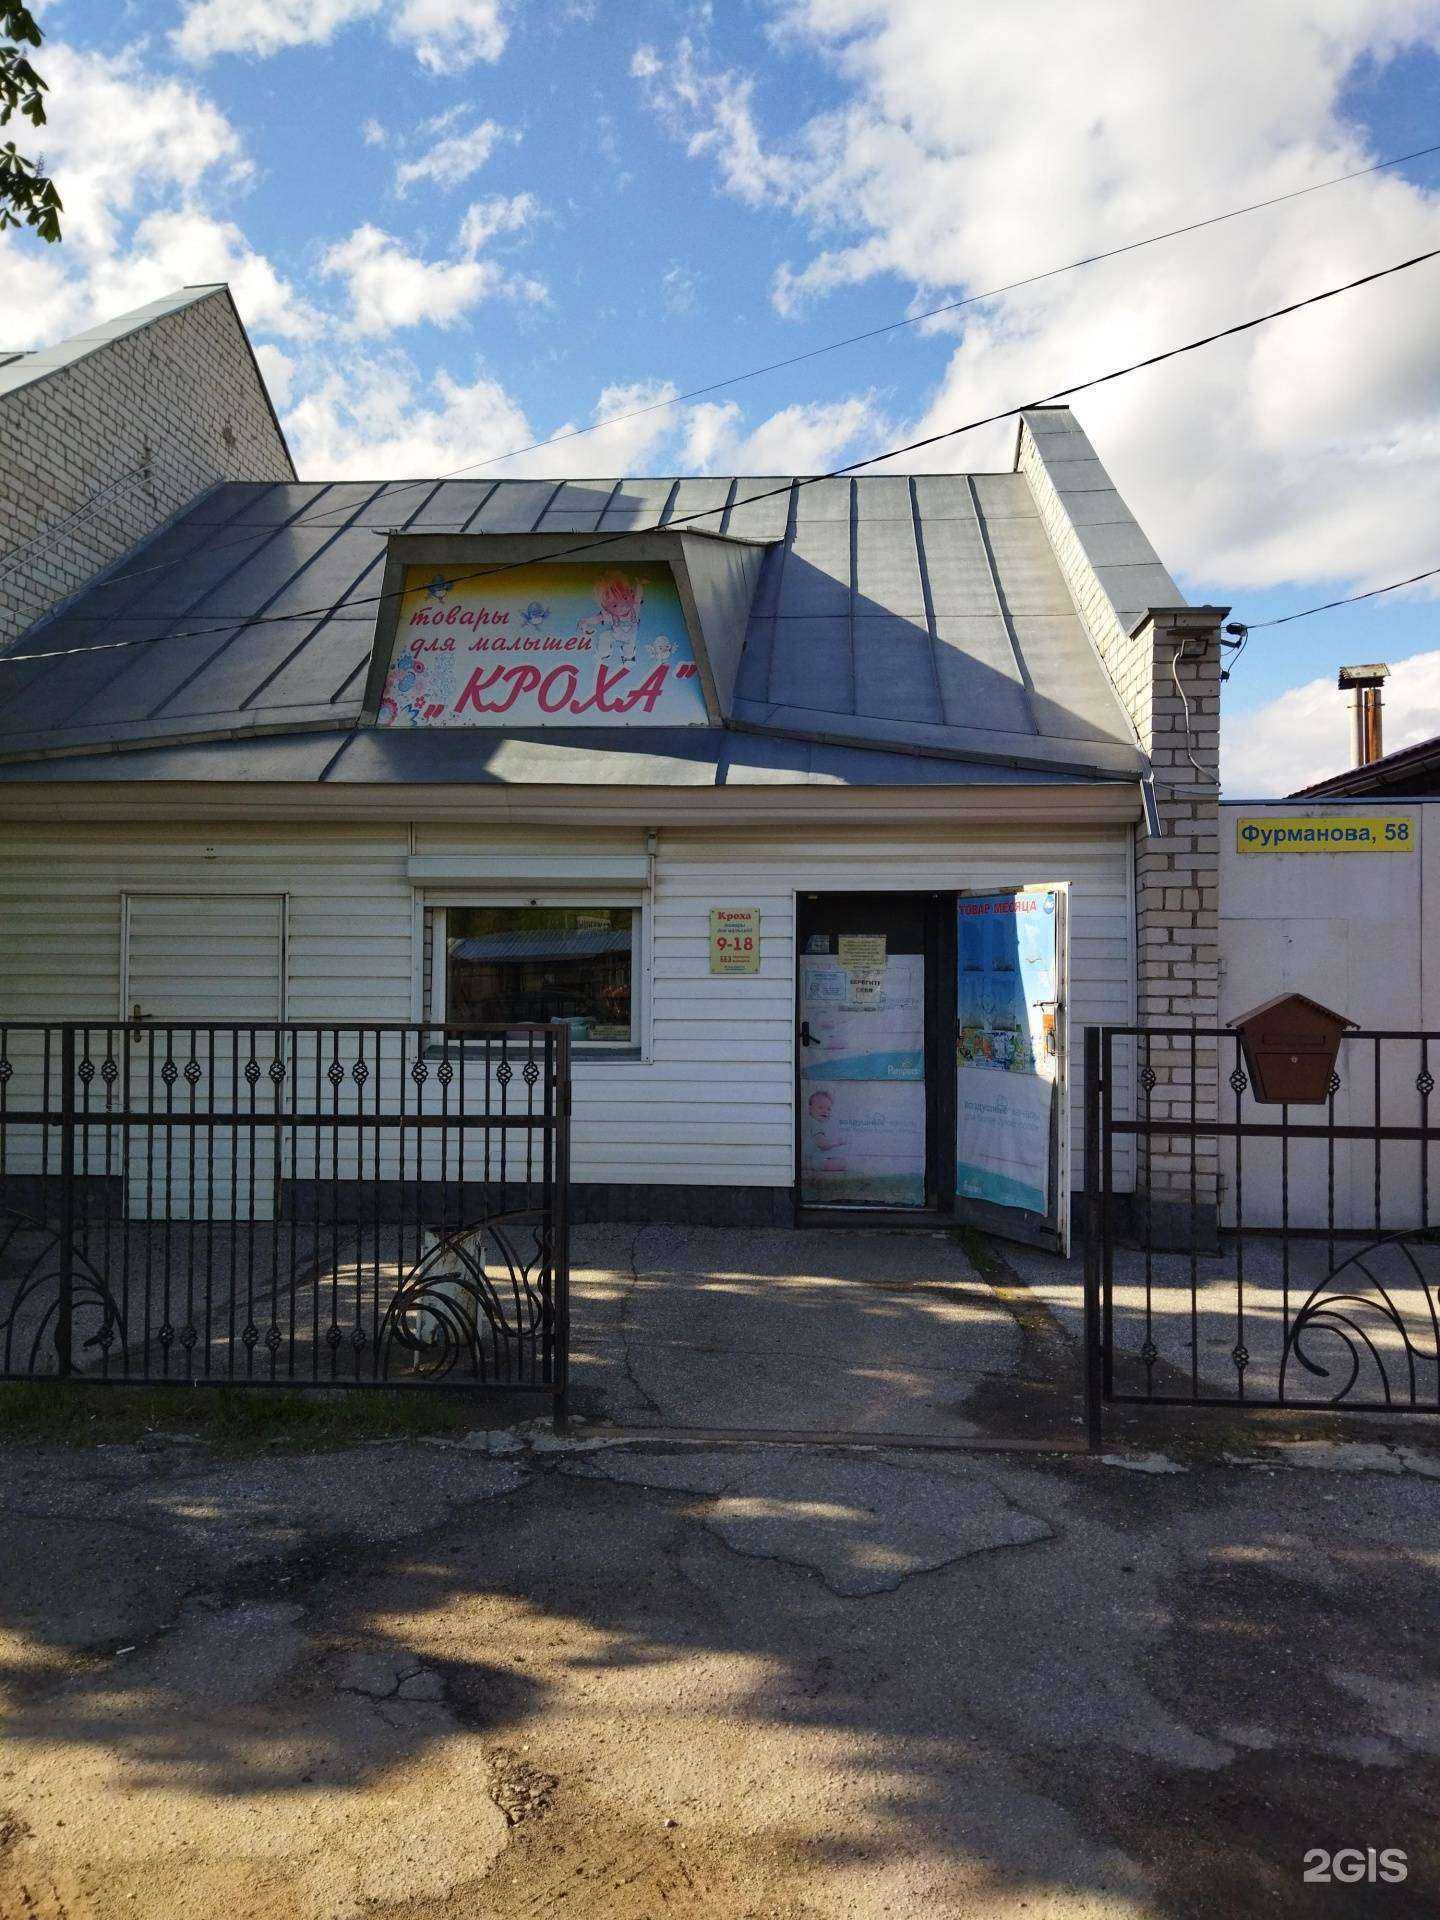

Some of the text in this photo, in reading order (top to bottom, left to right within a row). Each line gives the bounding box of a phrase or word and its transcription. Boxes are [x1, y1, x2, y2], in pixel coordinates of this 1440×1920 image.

[409, 605, 510, 634] товары
[409, 629, 593, 653] для малышей
[1241, 823, 1410, 847] Фурманова, 58
[717, 911, 752, 921] Кроха
[716, 937, 753, 951] 9-18
